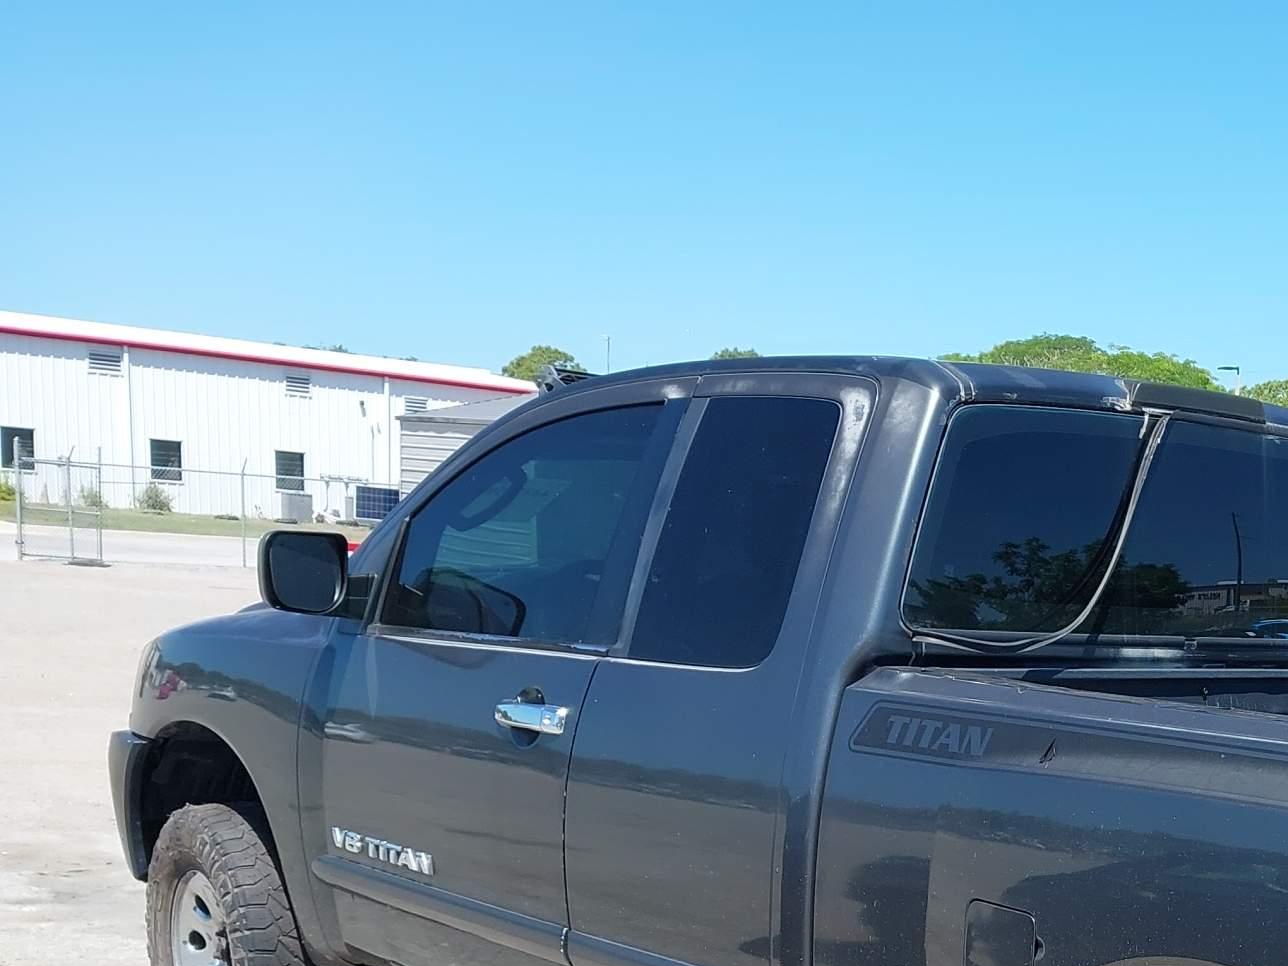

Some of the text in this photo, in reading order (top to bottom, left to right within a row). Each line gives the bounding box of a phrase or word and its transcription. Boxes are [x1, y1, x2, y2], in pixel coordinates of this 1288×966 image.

[886, 715, 993, 757] TITAN
[332, 827, 434, 876] V8 TITAN
